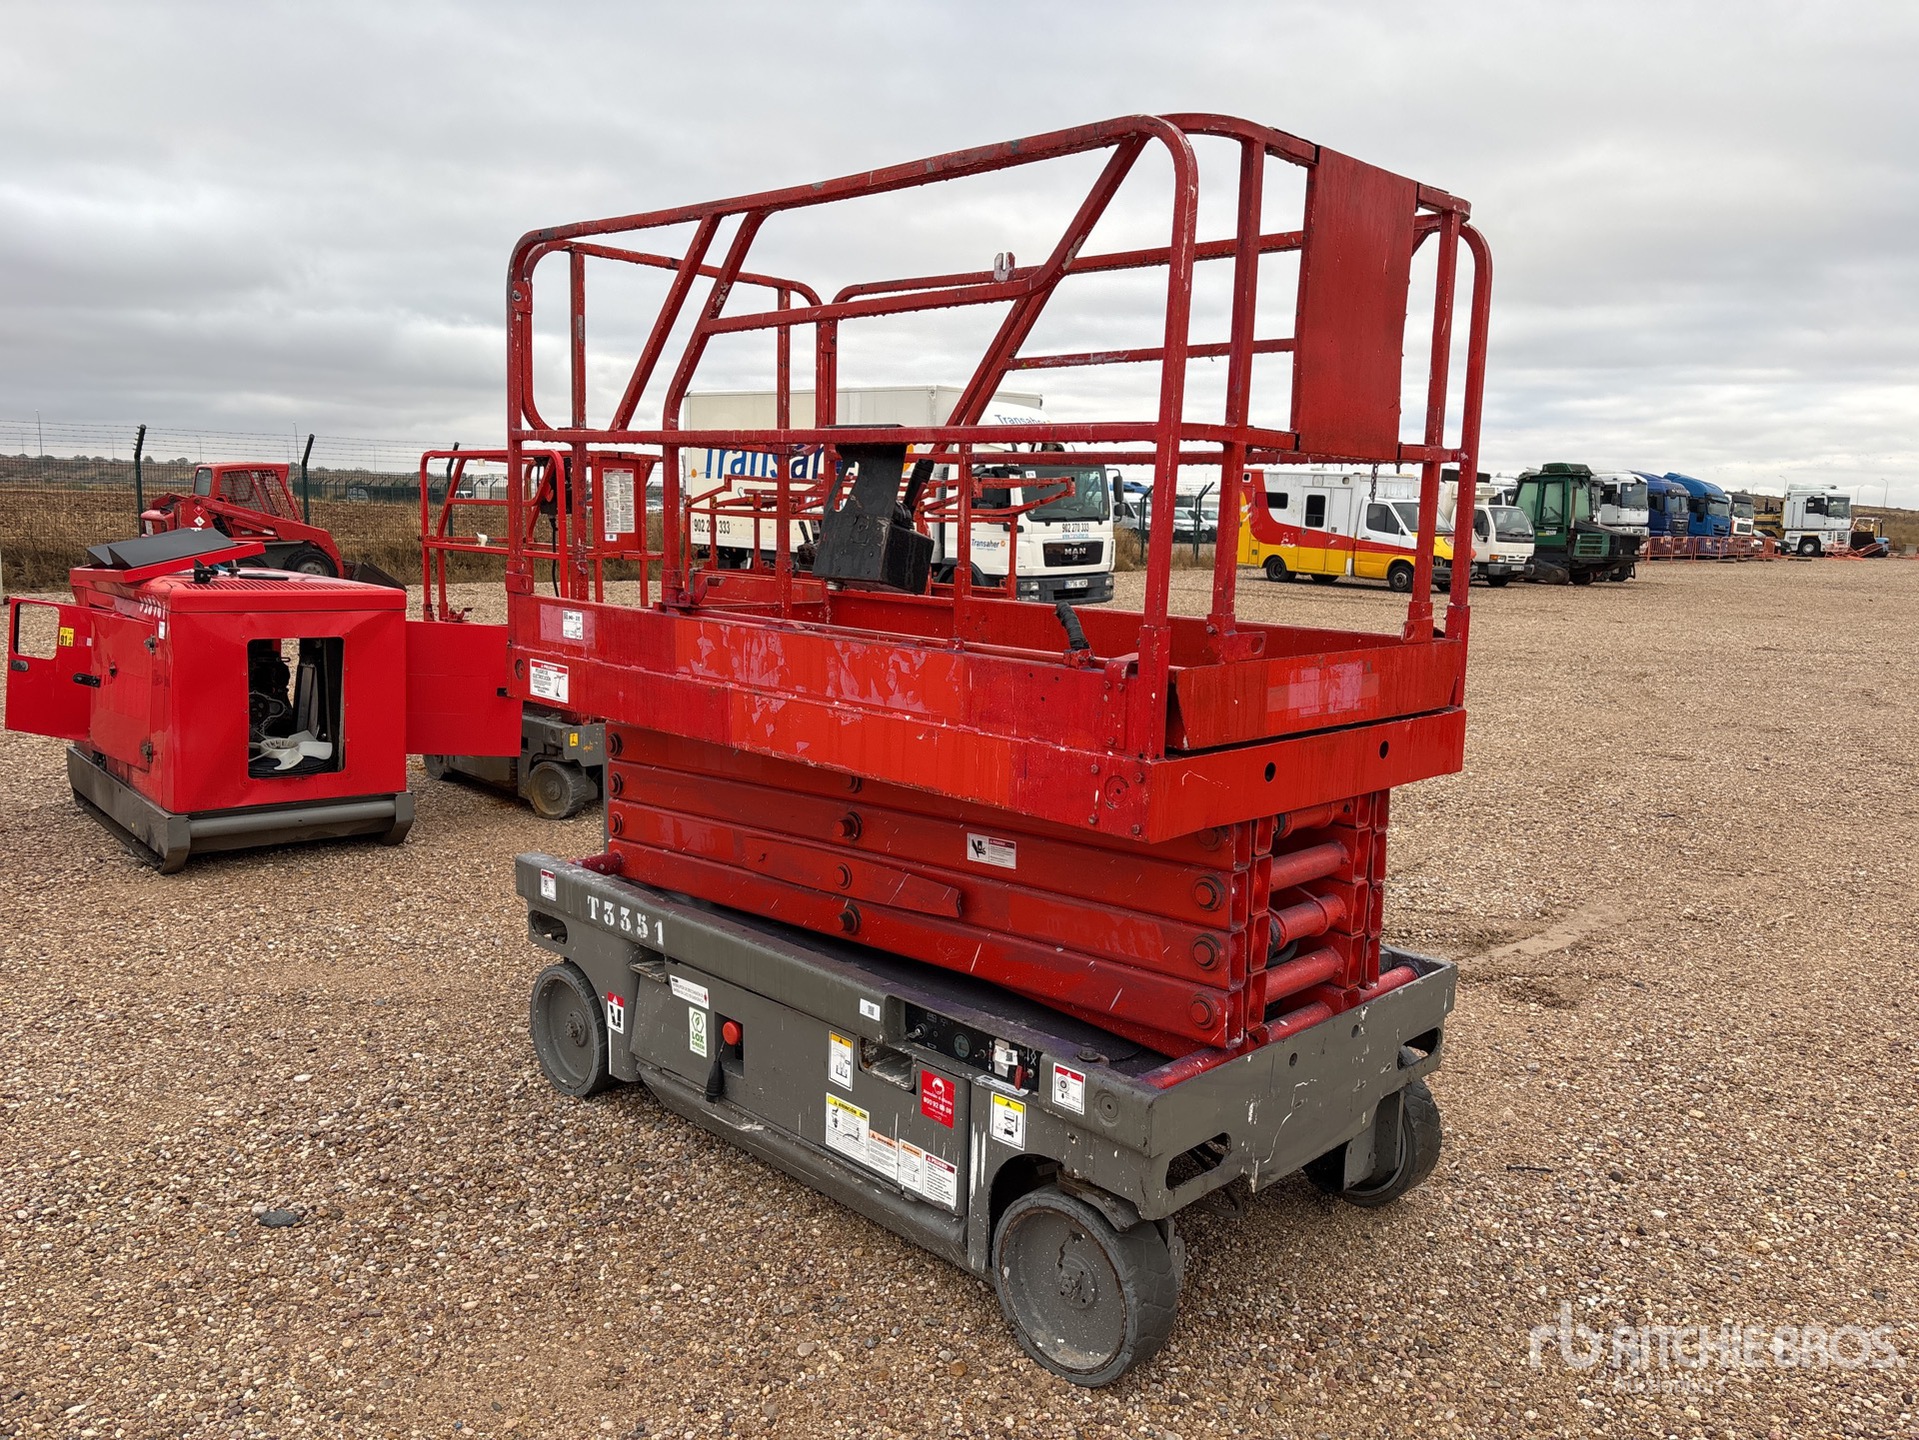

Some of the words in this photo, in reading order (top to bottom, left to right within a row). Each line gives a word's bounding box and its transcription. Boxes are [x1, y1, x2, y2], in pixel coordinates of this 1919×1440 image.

[693, 518, 705, 532] 902
[719, 520, 731, 534] 333
[1064, 547, 1087, 556] MAN
[60, 634, 68, 645] 91
[587, 895, 664, 947] T3351
[691, 1031, 705, 1044] LOX
[691, 1041, 705, 1051] GREEN
